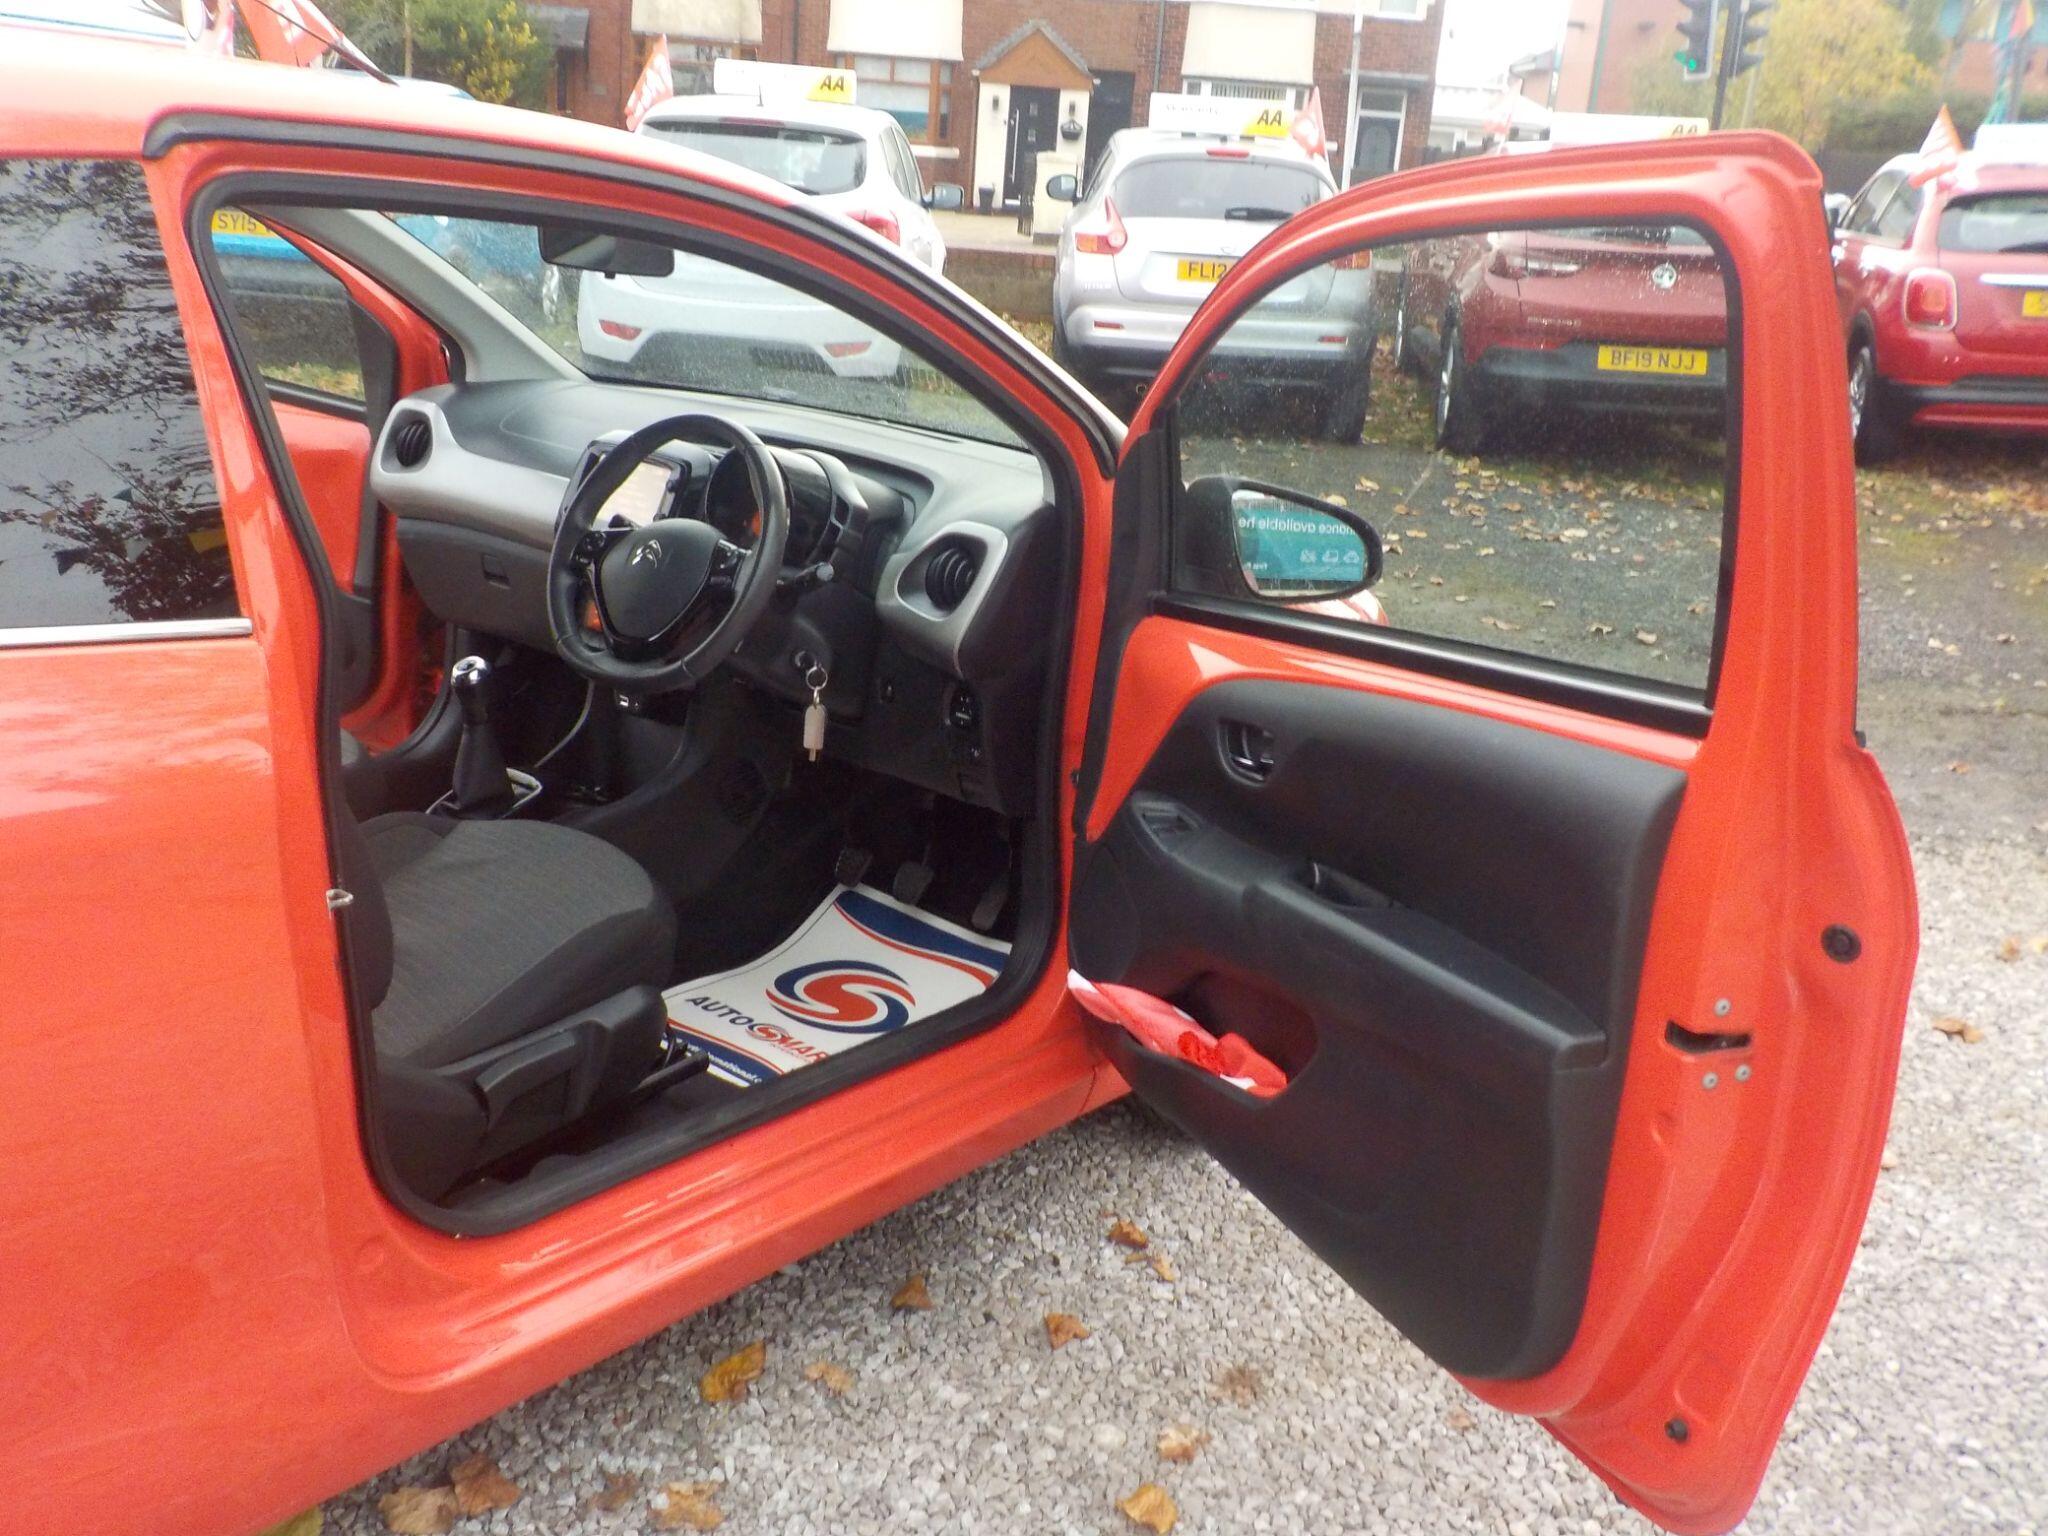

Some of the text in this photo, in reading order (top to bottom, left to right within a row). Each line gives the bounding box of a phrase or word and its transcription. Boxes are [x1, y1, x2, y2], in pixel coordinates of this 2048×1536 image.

[820, 75, 844, 91] AA
[1257, 109, 1283, 126] AA
[218, 212, 257, 232] SY15
[1188, 261, 1227, 279] FL12
[1611, 350, 1695, 370] BF19 NJJ
